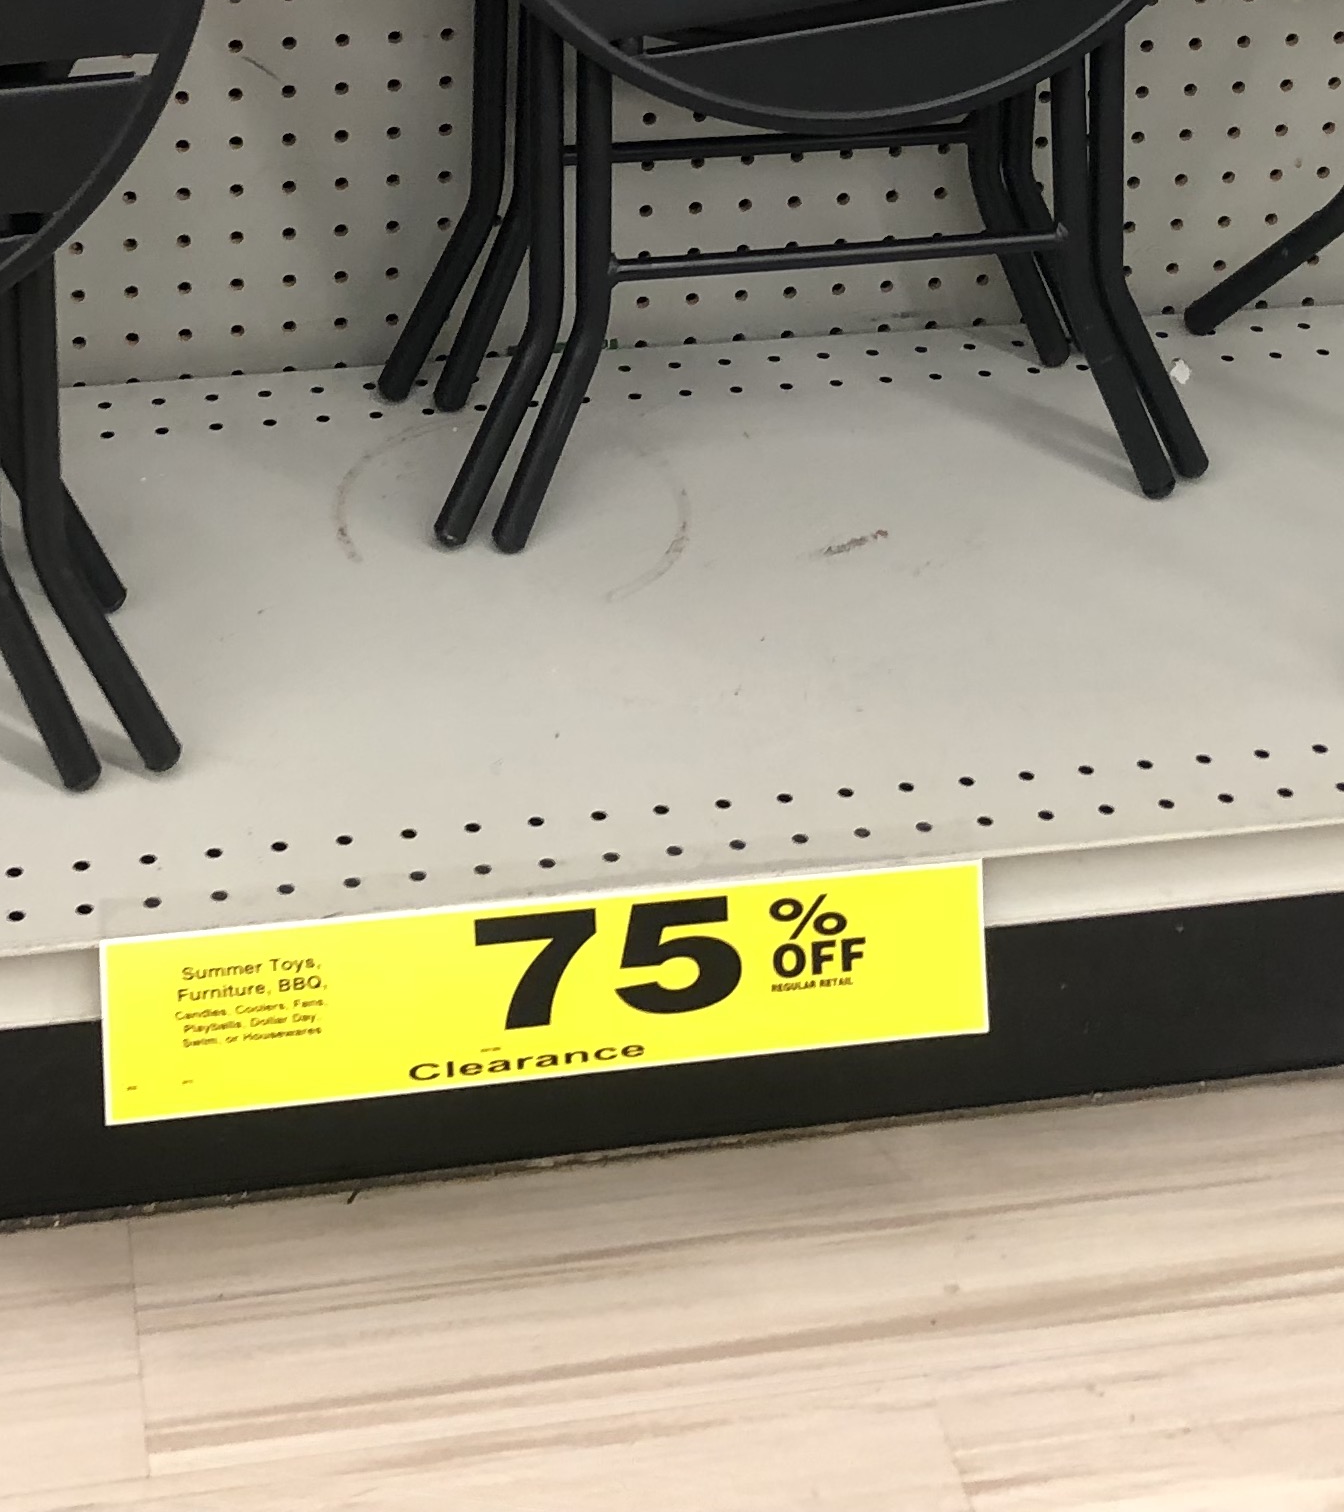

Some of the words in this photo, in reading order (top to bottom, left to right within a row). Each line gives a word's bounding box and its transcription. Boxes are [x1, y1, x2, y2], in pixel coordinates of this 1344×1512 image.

[182, 962, 263, 981] Summer
[269, 957, 321, 973] Toys,
[474, 895, 742, 1030] 75
[769, 893, 847, 940] %
[773, 937, 866, 978] OFF
[177, 983, 272, 1002] Furniture,
[278, 975, 328, 992] BBQ,
[771, 980, 816, 992] REGULAR
[819, 977, 853, 988] RETAIL
[409, 1044, 645, 1081] Clearance
